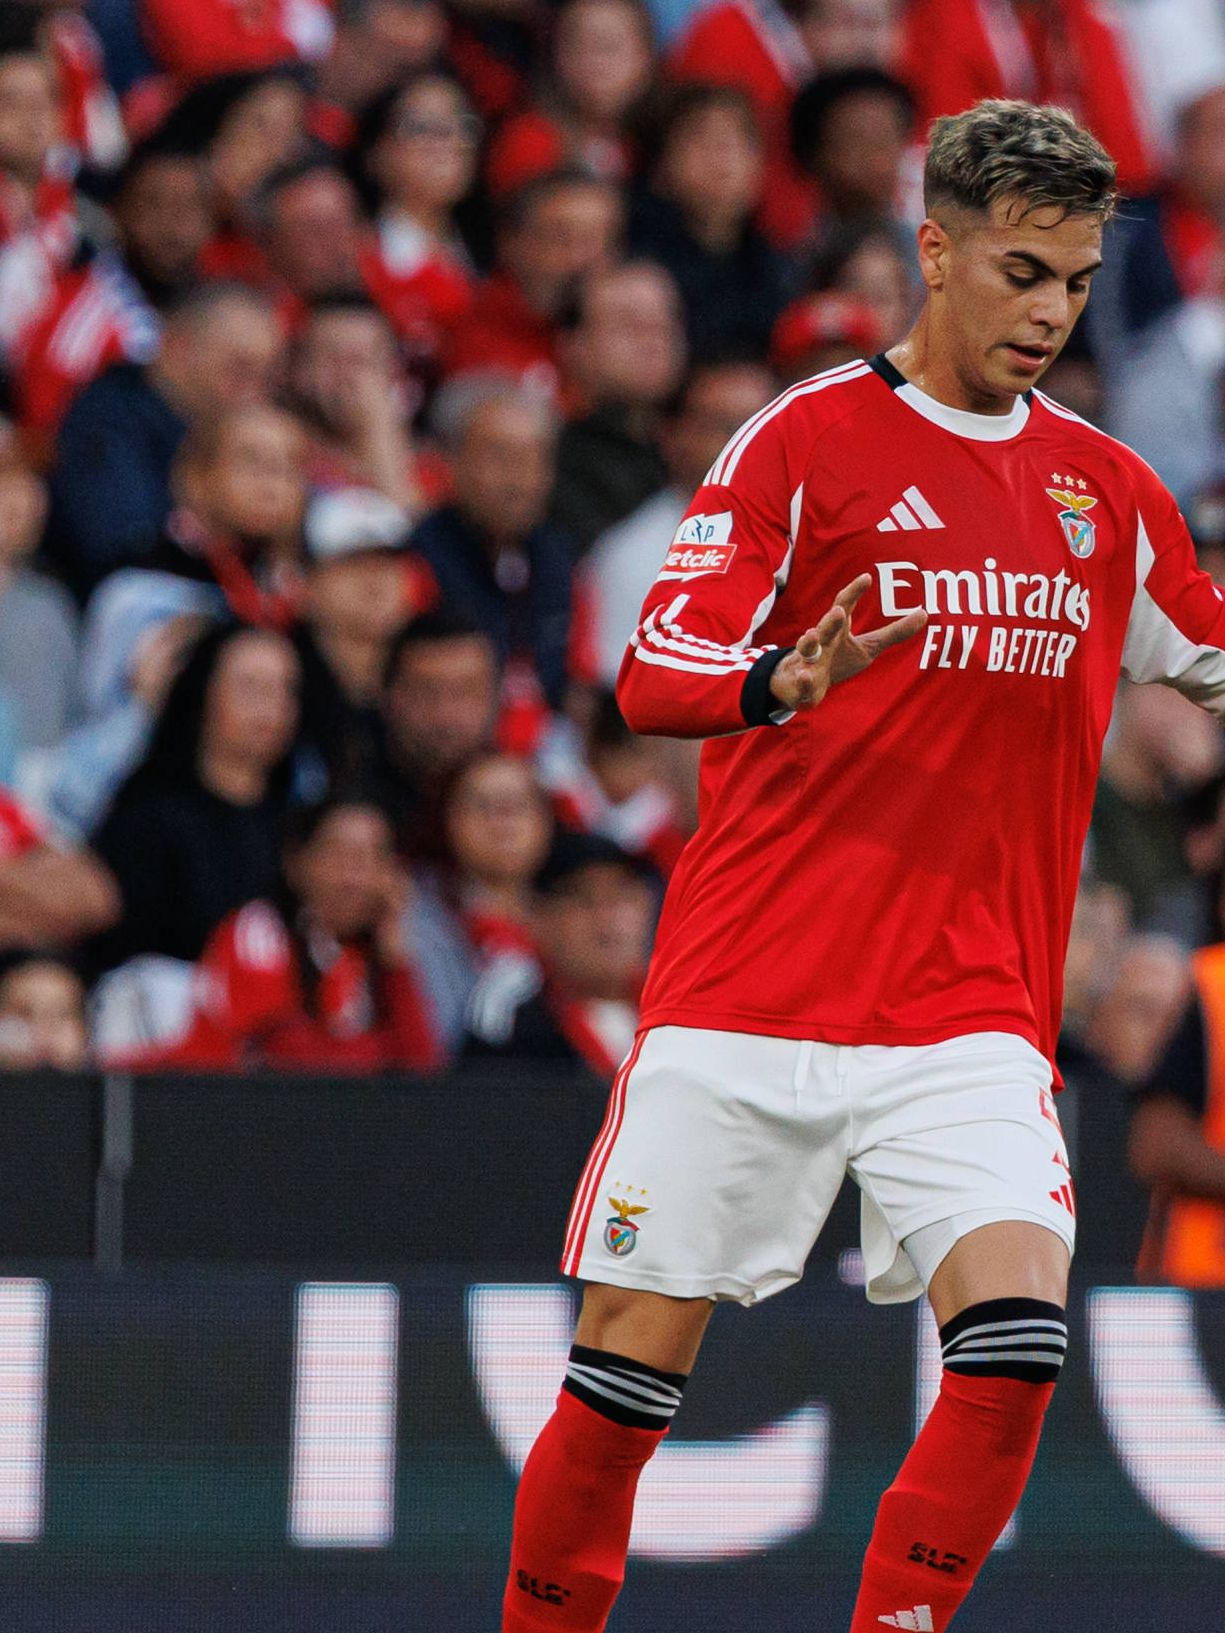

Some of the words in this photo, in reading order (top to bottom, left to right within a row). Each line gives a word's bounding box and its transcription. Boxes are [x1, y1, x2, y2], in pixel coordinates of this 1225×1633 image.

[875, 557, 1091, 632] Emirates
[919, 625, 979, 670] FLY
[986, 627, 1078, 678] BETTER
